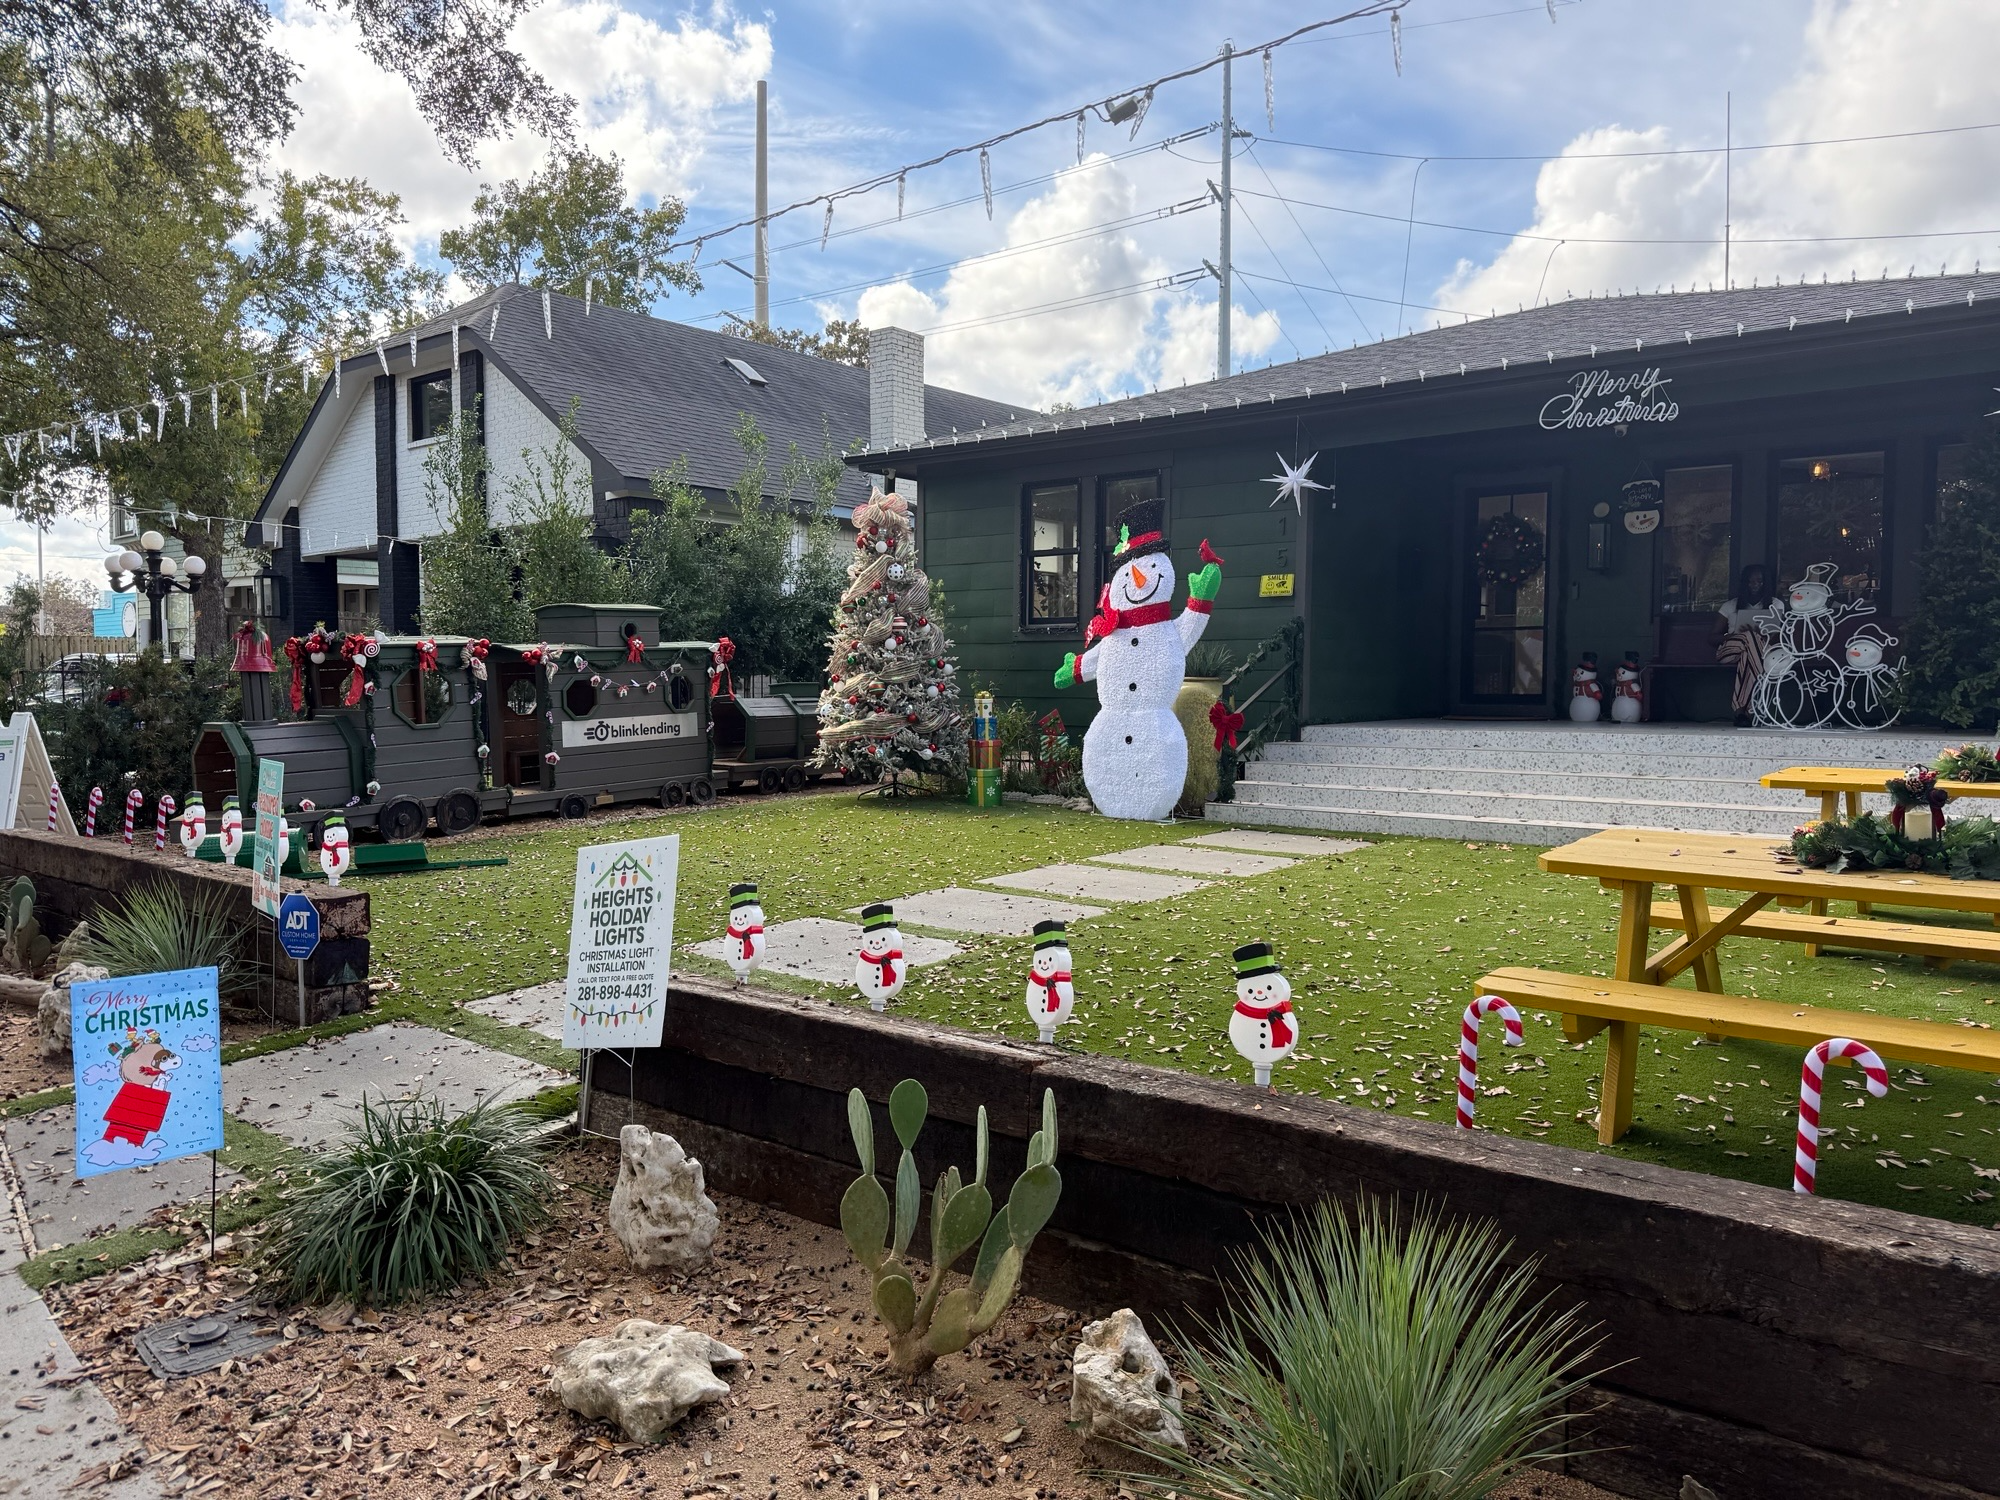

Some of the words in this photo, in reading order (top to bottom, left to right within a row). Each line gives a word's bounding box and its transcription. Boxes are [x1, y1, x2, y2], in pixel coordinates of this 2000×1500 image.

[1567, 367, 1672, 400] Merry
[1539, 395, 1679, 429] Christmas
[591, 886, 653, 909] HEIGHTS
[285, 911, 310, 930] ADT
[590, 906, 652, 928] HOLIDAY
[281, 930, 300, 938] CUSTOM
[594, 926, 645, 946] LIGHTS
[579, 949, 626, 962] CHRISTMAS
[629, 947, 654, 958] LIGHT
[587, 960, 645, 973] INSTALLATION
[638, 973, 654, 981] QUOTE
[578, 983, 652, 1001] 281-898-4431
[83, 990, 149, 1016] Merry
[85, 998, 209, 1034] CHRISTMAS
